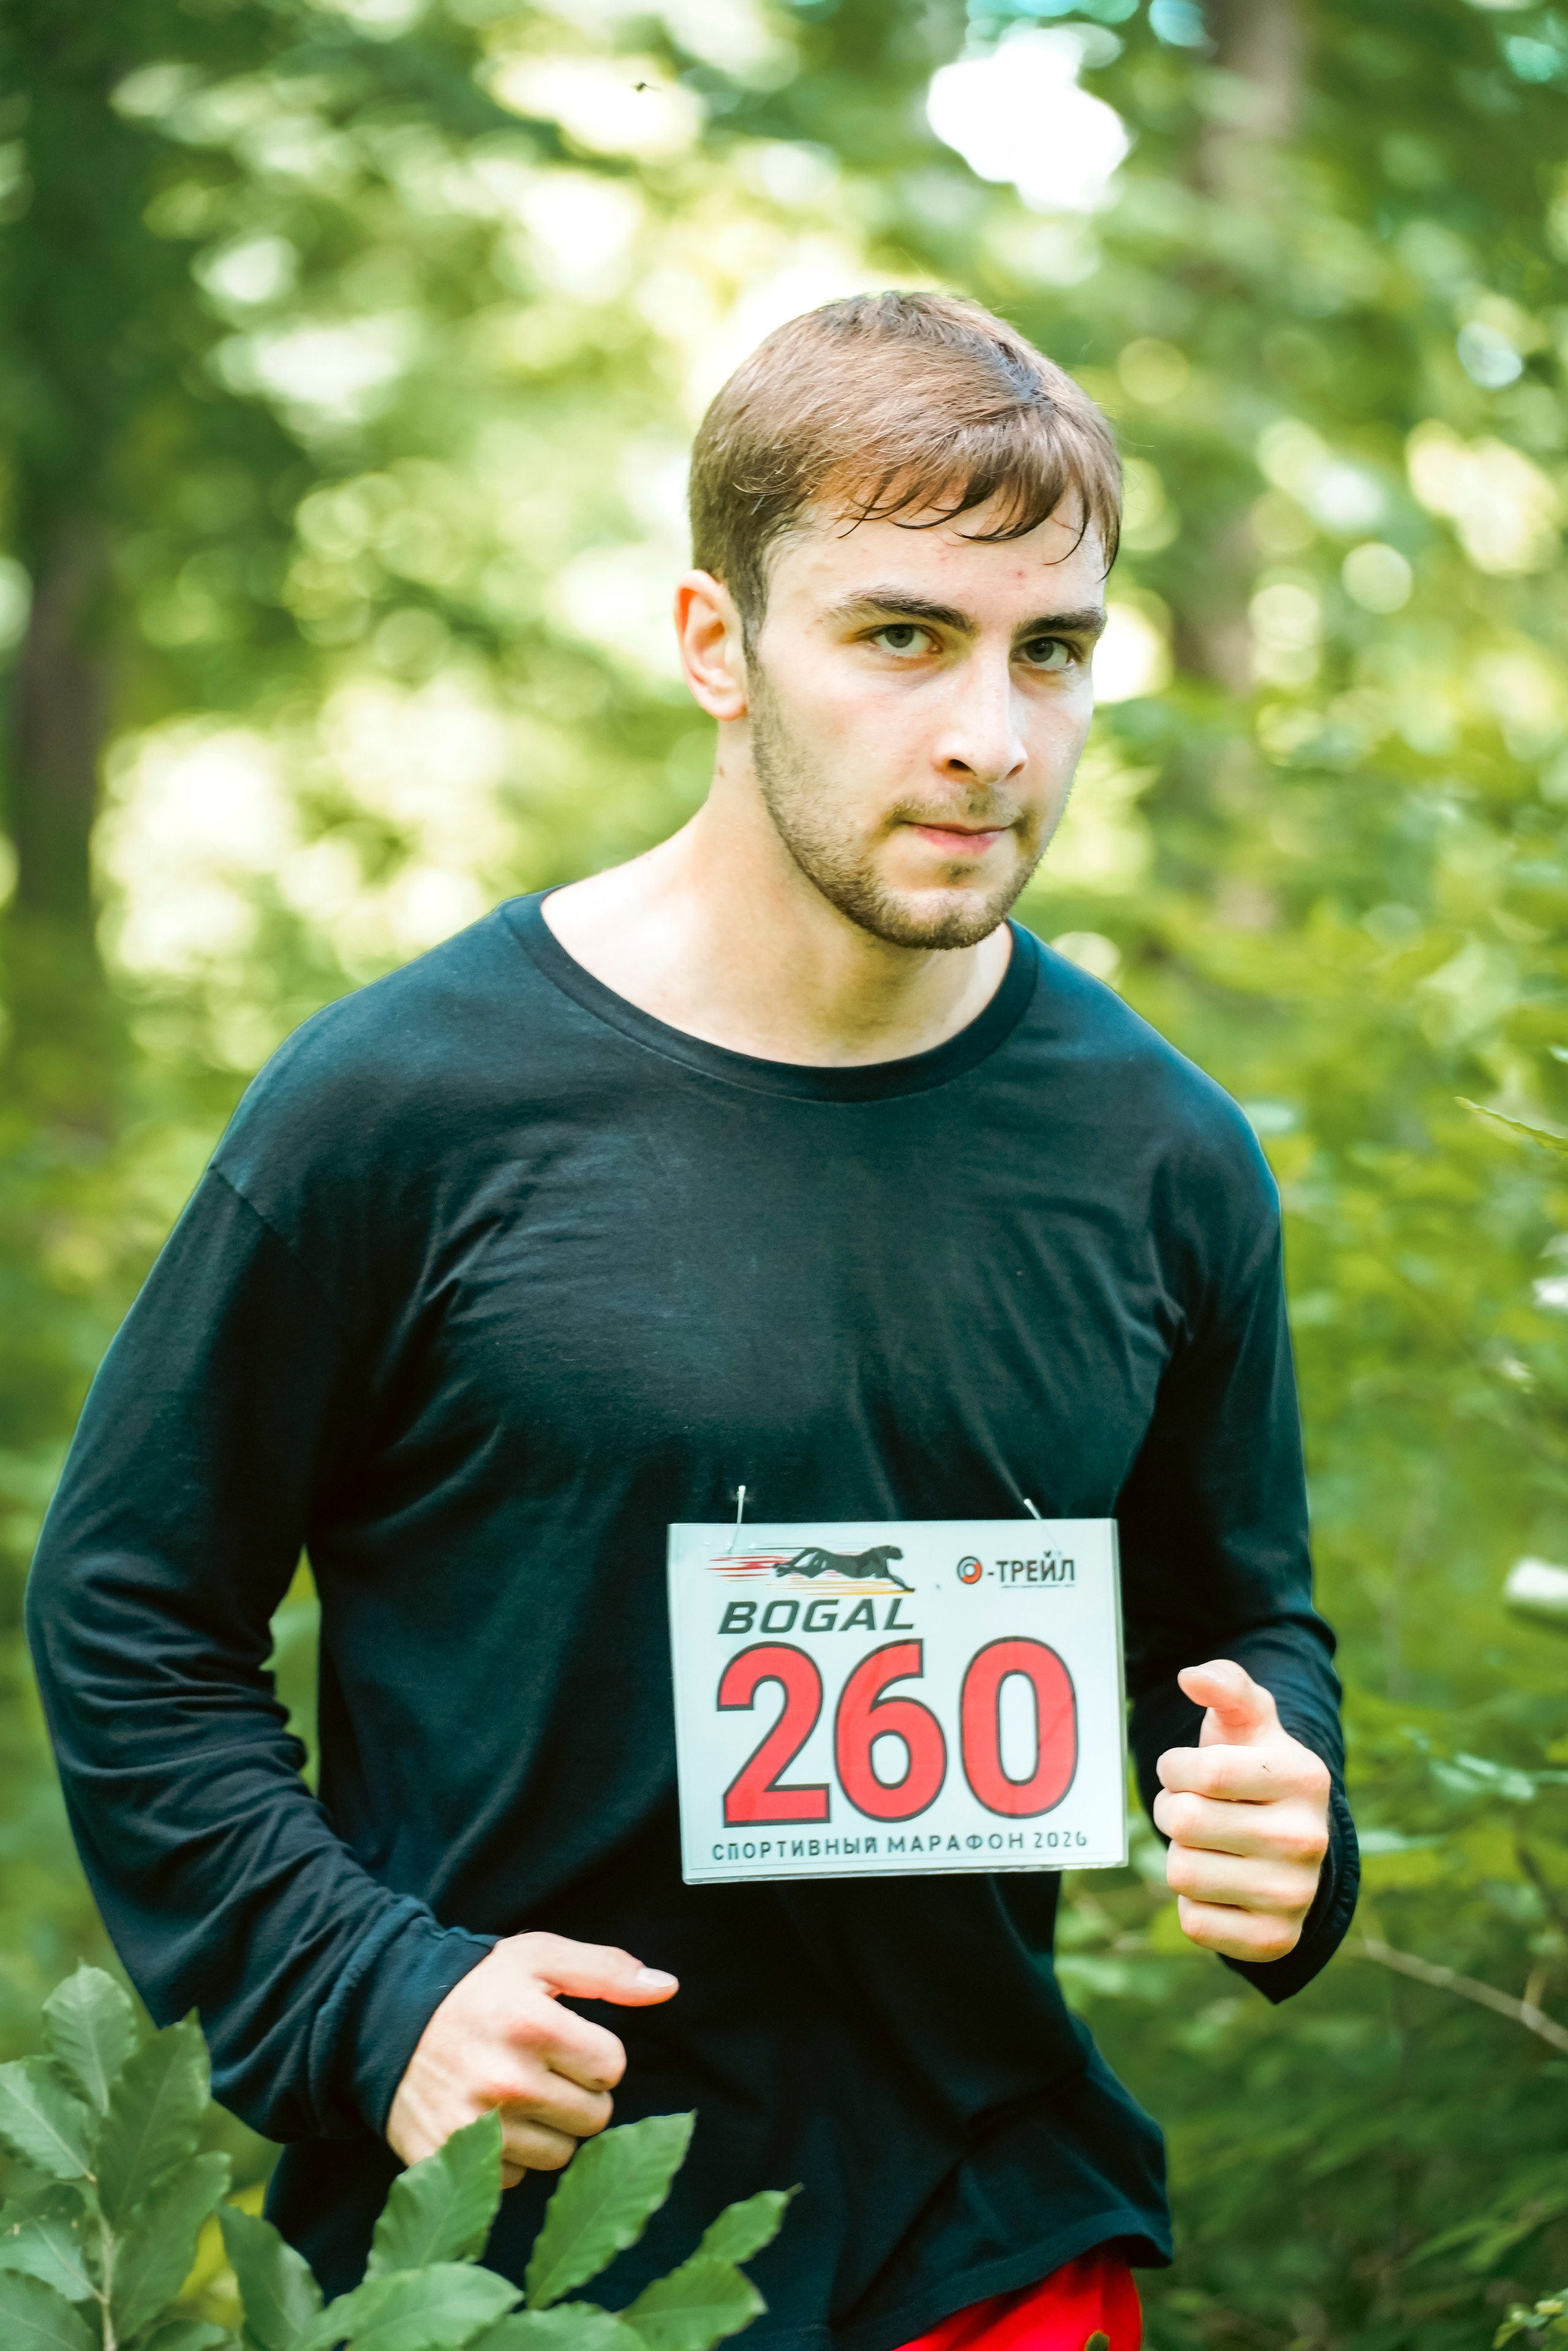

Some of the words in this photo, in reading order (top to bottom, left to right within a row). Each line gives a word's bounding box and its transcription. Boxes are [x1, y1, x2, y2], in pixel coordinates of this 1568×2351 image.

[717, 1598, 915, 1634] BOGAL
[716, 1636, 1079, 1828] 260
[712, 1836, 878, 1860] СПОРТИВНЫЙ
[888, 1832, 1023, 1853] МАРАФОН
[1033, 1831, 1088, 1849] 2026
